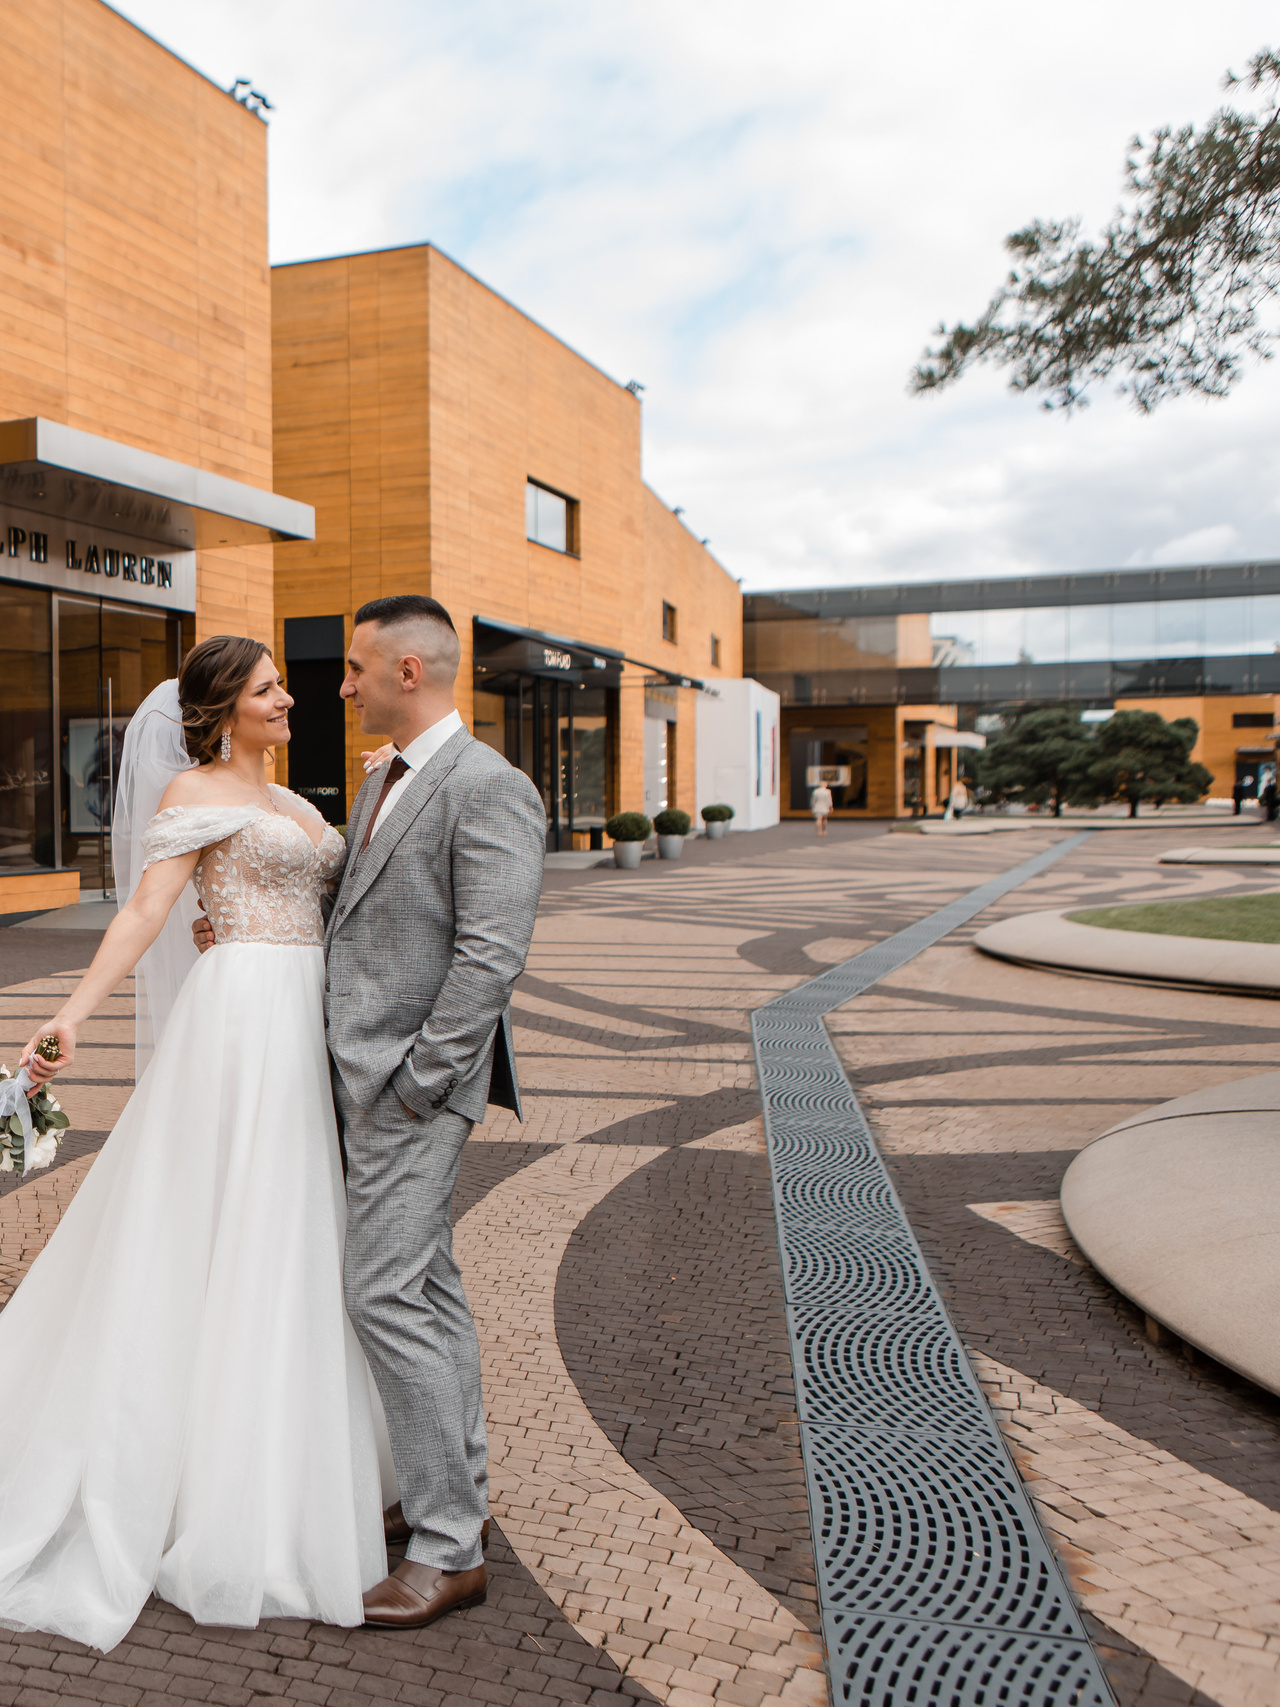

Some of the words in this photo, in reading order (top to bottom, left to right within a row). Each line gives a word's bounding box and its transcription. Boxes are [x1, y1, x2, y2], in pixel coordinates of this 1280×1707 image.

[66, 539, 172, 588] LAUREN
[299, 787, 316, 795] TOM
[317, 786, 339, 796] FORD
